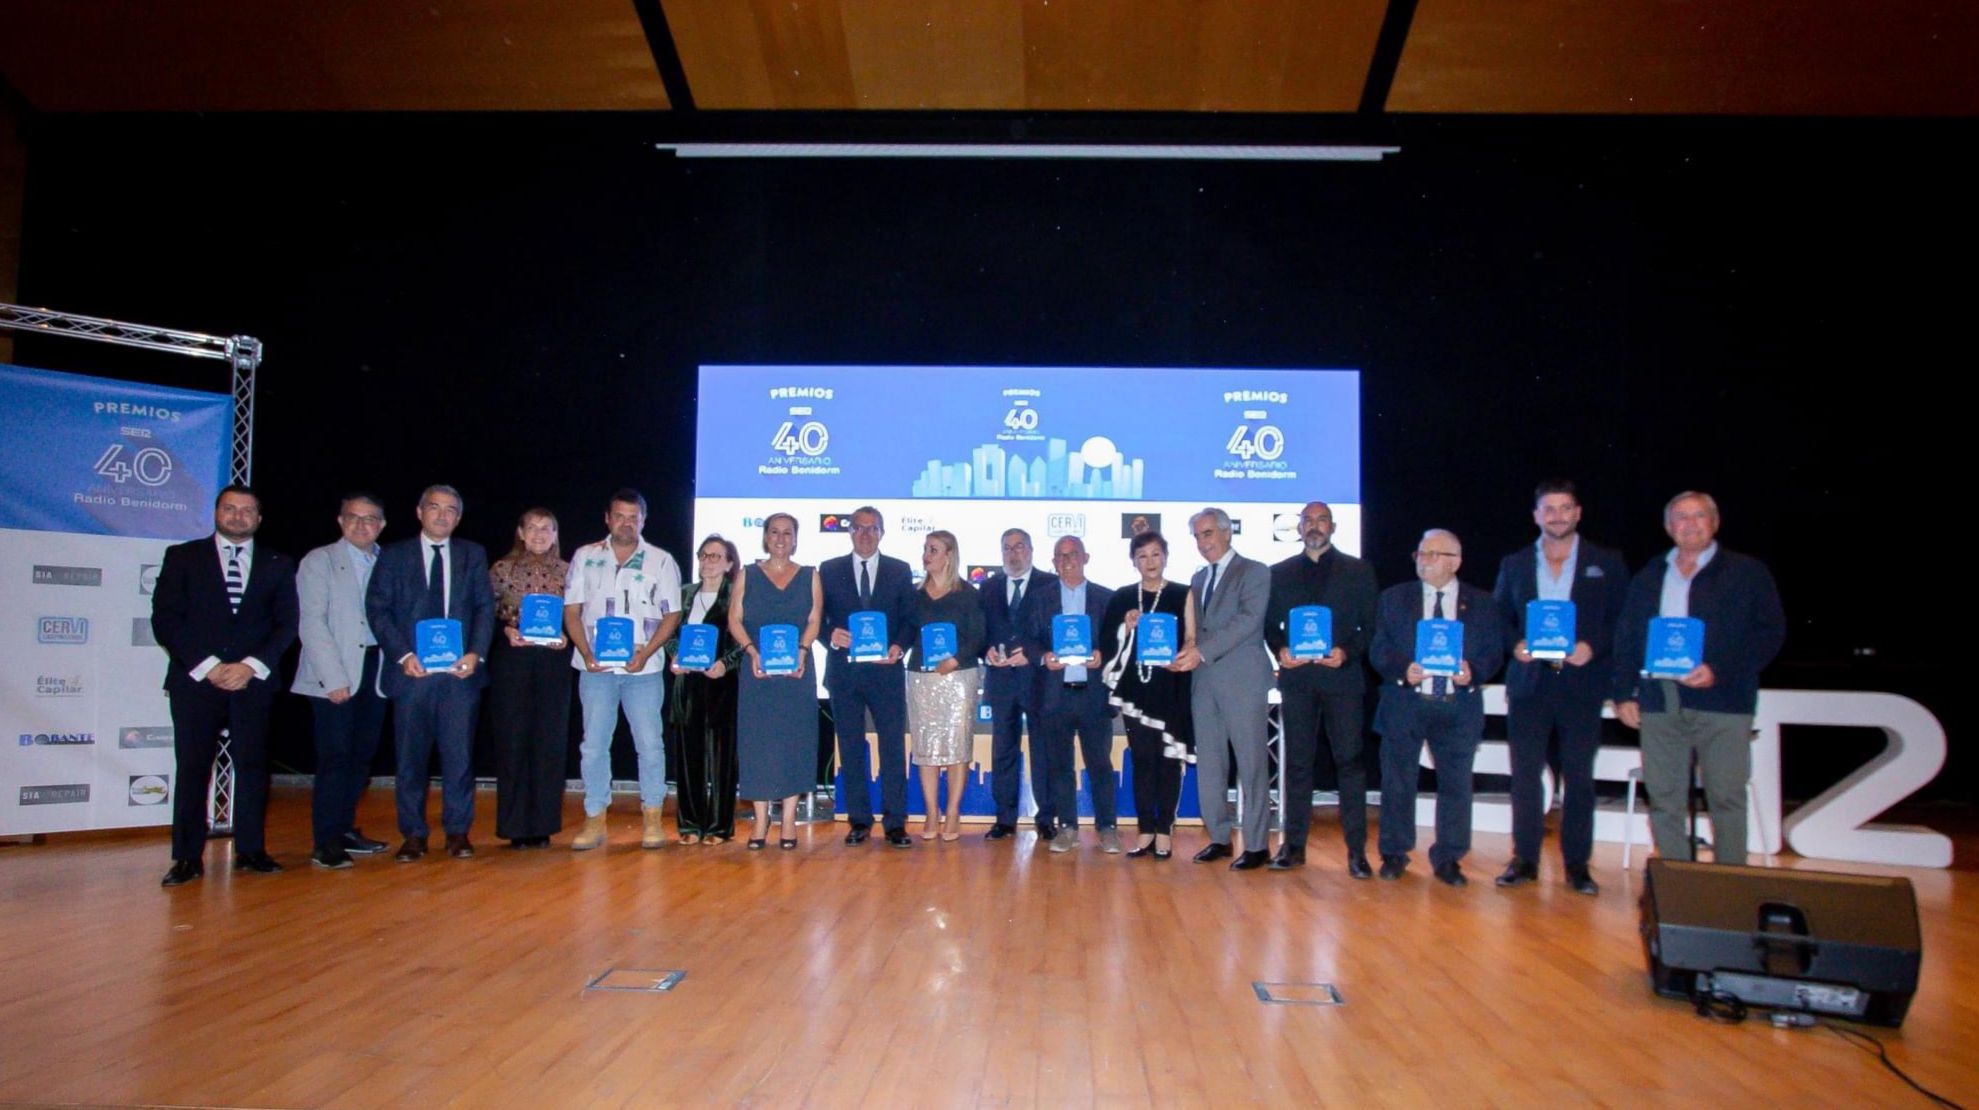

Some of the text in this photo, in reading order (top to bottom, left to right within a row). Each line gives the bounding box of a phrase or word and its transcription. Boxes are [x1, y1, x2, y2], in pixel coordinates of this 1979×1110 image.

[770, 387, 833, 400] PREMIOS
[1224, 390, 1288, 404] PREMIOS
[94, 402, 182, 422] PREMIOS
[1004, 408, 1039, 430] 40
[120, 426, 152, 439] SER
[771, 421, 828, 456] 40
[1226, 425, 1284, 460] 40
[94, 444, 172, 486] 40
[758, 465, 840, 475] Radio Benidorm
[1214, 469, 1245, 479] Radio
[74, 492, 188, 512] Radio Benidorm
[35, 570, 53, 579] SIA
[43, 620, 84, 634] CERVI
[36, 685, 82, 696] Capilar
[22, 791, 40, 800] SIA
